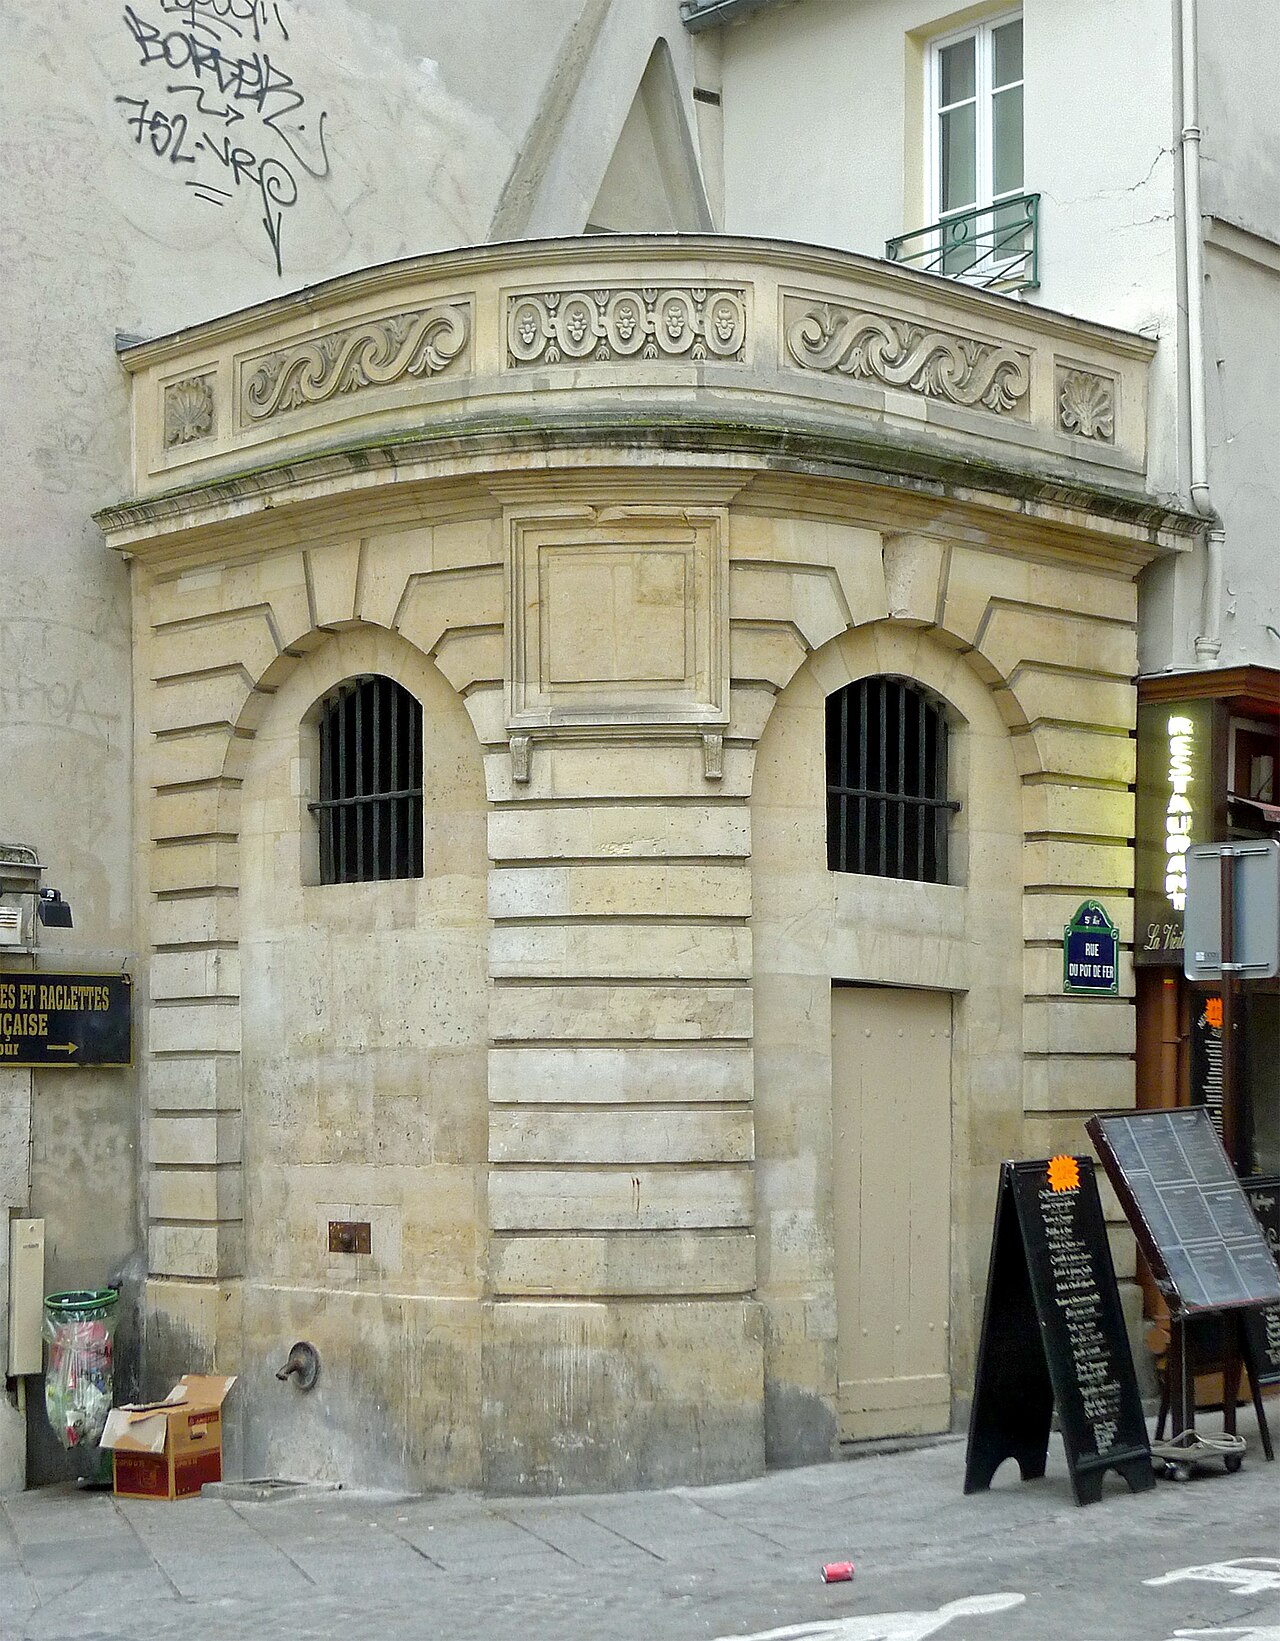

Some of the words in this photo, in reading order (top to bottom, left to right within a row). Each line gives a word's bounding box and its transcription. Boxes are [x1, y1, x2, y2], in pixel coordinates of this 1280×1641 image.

[1165, 715, 1194, 911] RESTAURANT
[1085, 942, 1100, 957] RUE
[1143, 923, 1161, 951] La
[1069, 962, 1079, 977] DU
[1079, 963, 1092, 978] POT
[1092, 964, 1102, 978] DE
[1102, 965, 1114, 979] FER
[20, 984, 36, 1010] ET
[39, 984, 110, 1012] RACLETTES
[0, 1012, 48, 1041] ÇAISE
